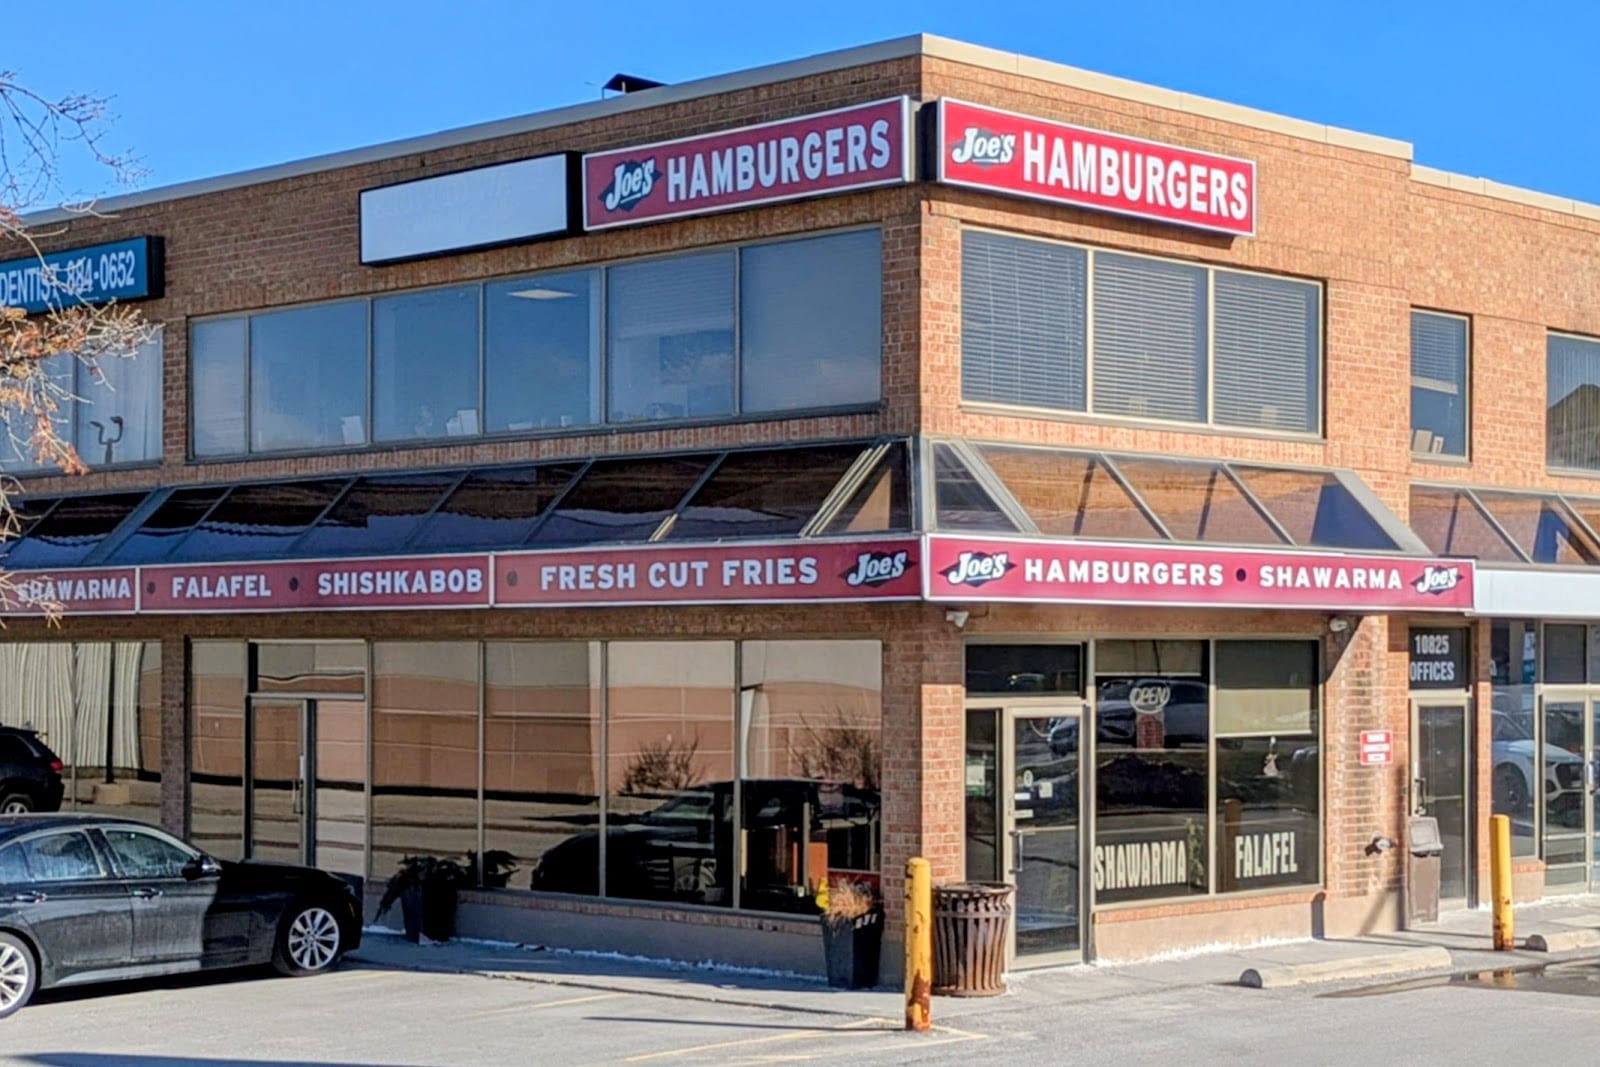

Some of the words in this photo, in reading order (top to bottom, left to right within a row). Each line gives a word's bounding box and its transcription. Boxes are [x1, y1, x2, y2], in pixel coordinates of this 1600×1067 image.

[667, 119, 891, 203] HAMBURGERS
[1023, 130, 1248, 220] HAMBURGERS
[18, 576, 132, 601] SHAWARMA
[172, 574, 272, 598] FALAFEL
[317, 568, 483, 596] SHISHKABOB
[540, 564, 637, 591] FRESH
[648, 561, 709, 588] CUT
[722, 557, 818, 586] FRIES
[1024, 558, 1224, 586] HAMBURGERS
[1259, 565, 1403, 590] SHAWARMA
[1414, 634, 1450, 655] 10825
[1409, 661, 1455, 682] OFFICES
[1130, 686, 1171, 706] OPEN
[1094, 840, 1188, 890] SHAWARMA
[1235, 831, 1298, 879] FALAFEL
